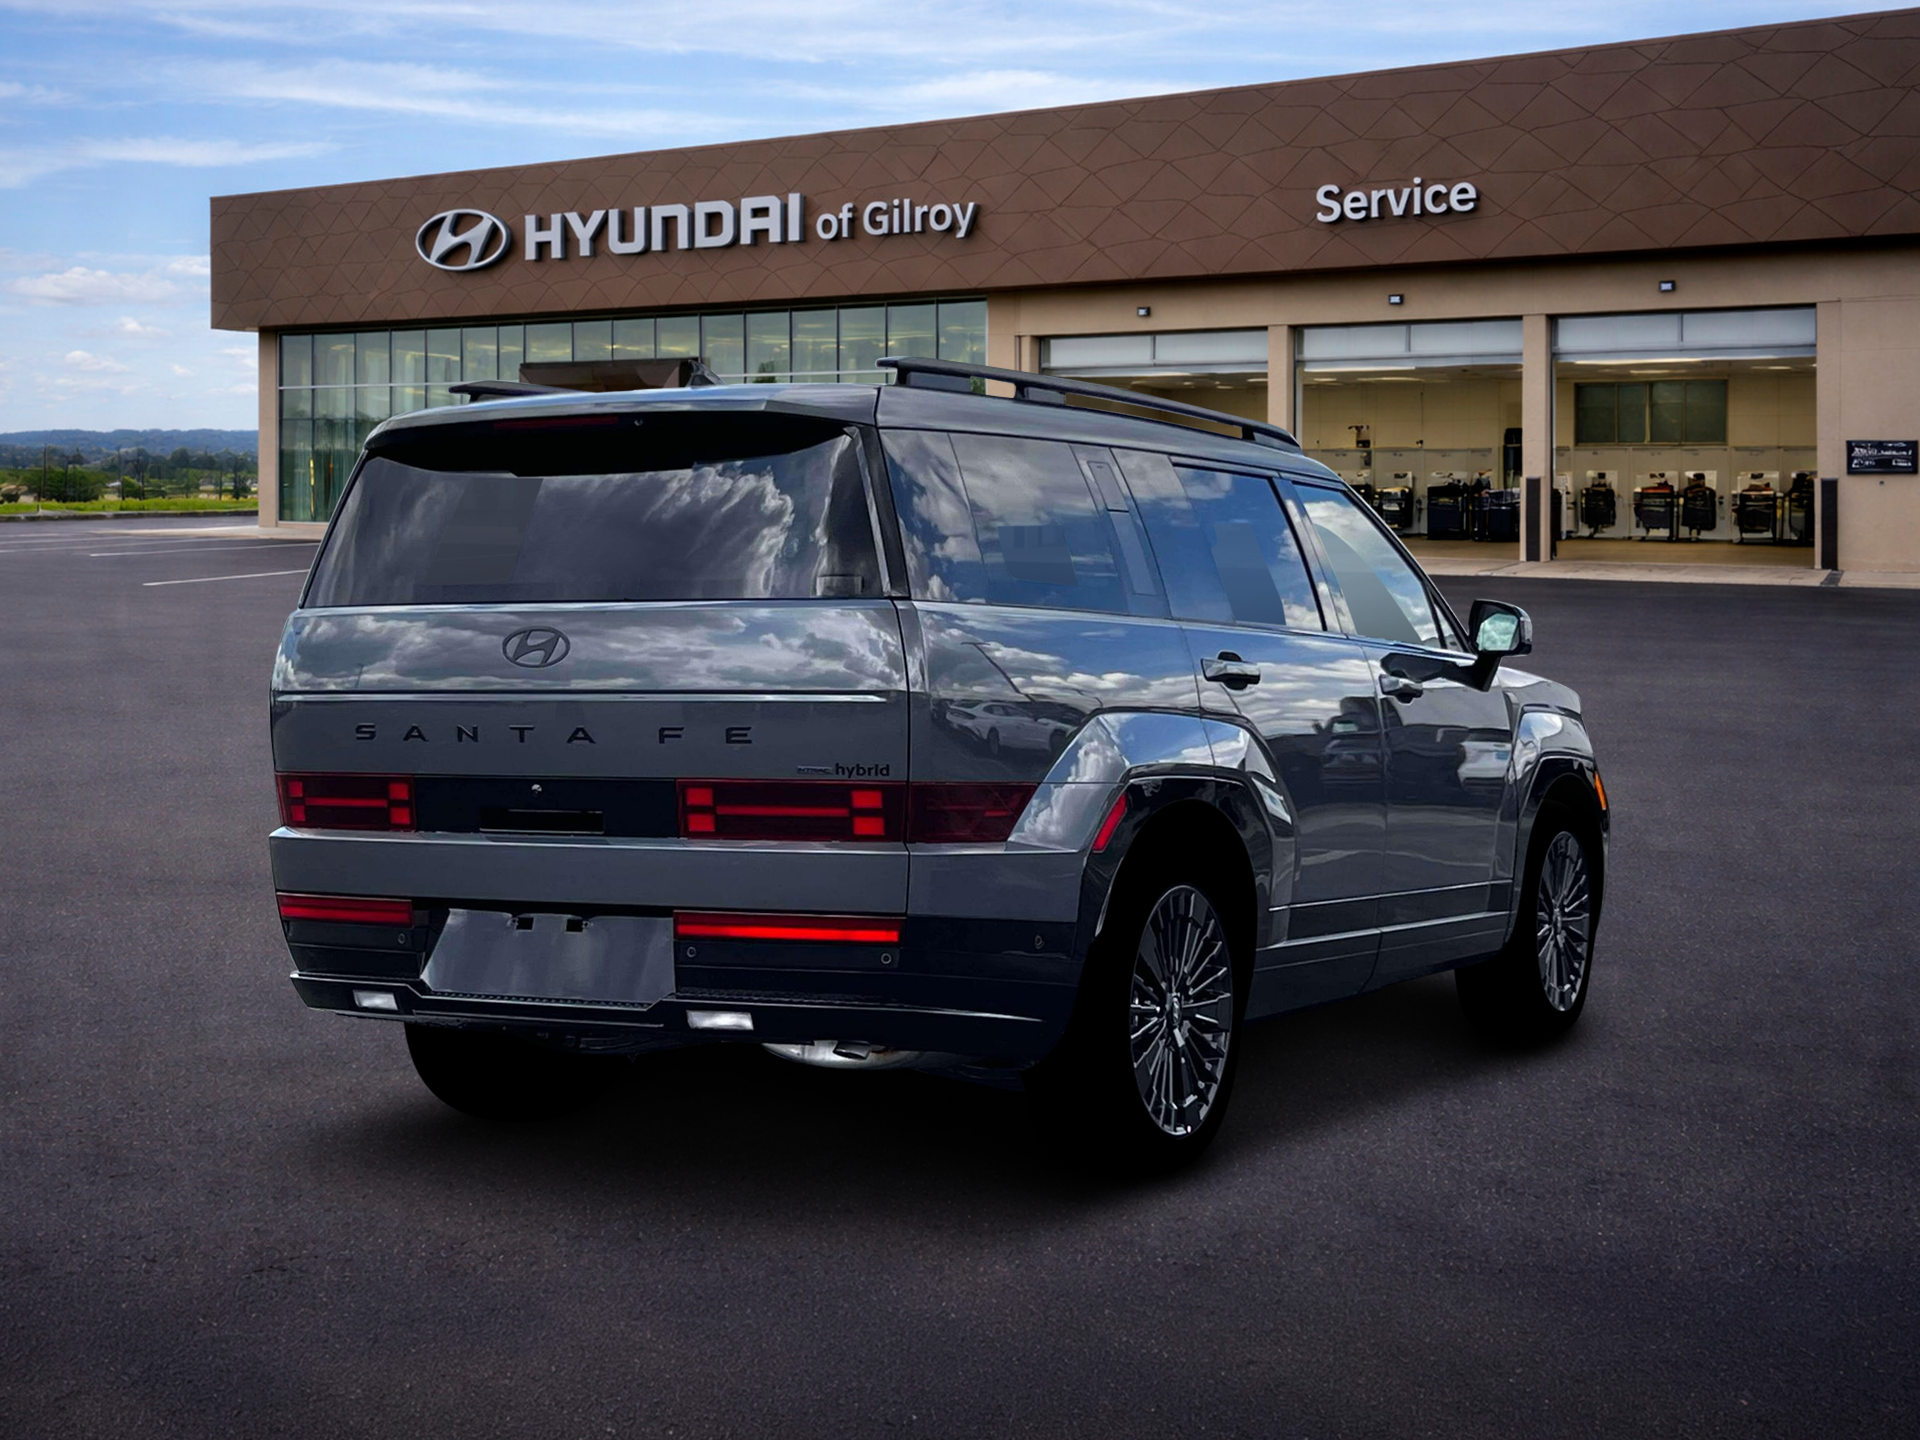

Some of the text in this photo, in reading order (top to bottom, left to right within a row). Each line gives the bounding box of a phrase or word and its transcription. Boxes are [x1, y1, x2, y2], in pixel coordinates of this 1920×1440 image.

[1315, 176, 1478, 223] Service
[524, 192, 976, 261] HYUNDAI of Gilroy
[355, 723, 754, 745] SANTA FE
[835, 762, 890, 779] hybrid
